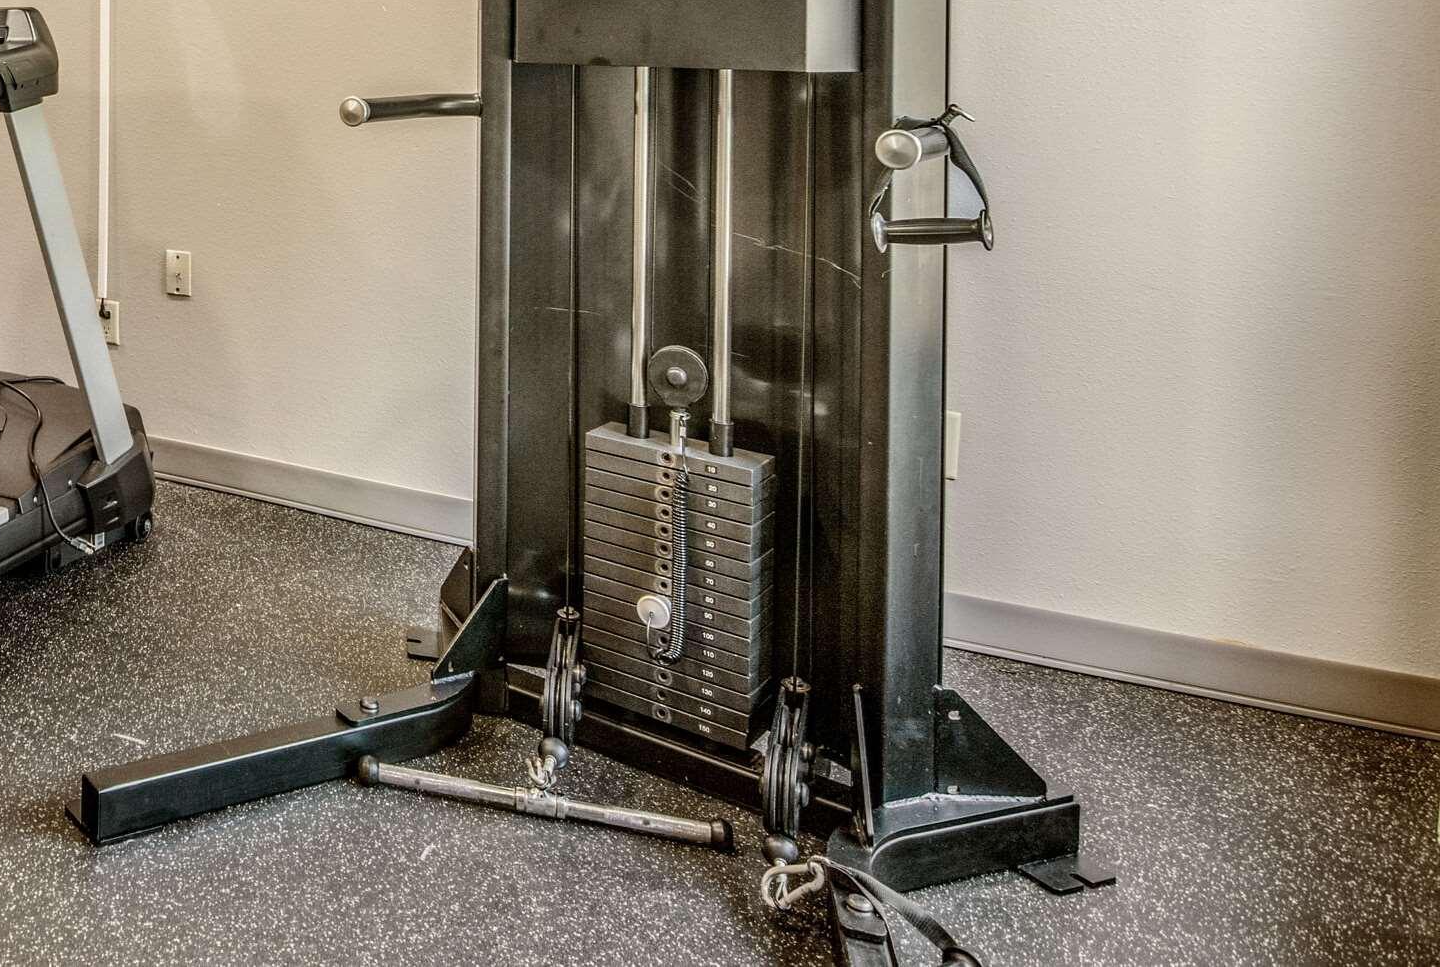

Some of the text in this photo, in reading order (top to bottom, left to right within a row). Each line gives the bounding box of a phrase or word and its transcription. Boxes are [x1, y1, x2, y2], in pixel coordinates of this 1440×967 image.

[708, 466, 716, 474] 10
[705, 577, 714, 585] 70
[704, 612, 713, 620] 90
[702, 632, 714, 641] 100
[703, 650, 715, 658] 110
[702, 669, 714, 678] 120
[701, 688, 713, 696] 130
[700, 706, 712, 715] 140
[698, 724, 710, 733] 150
